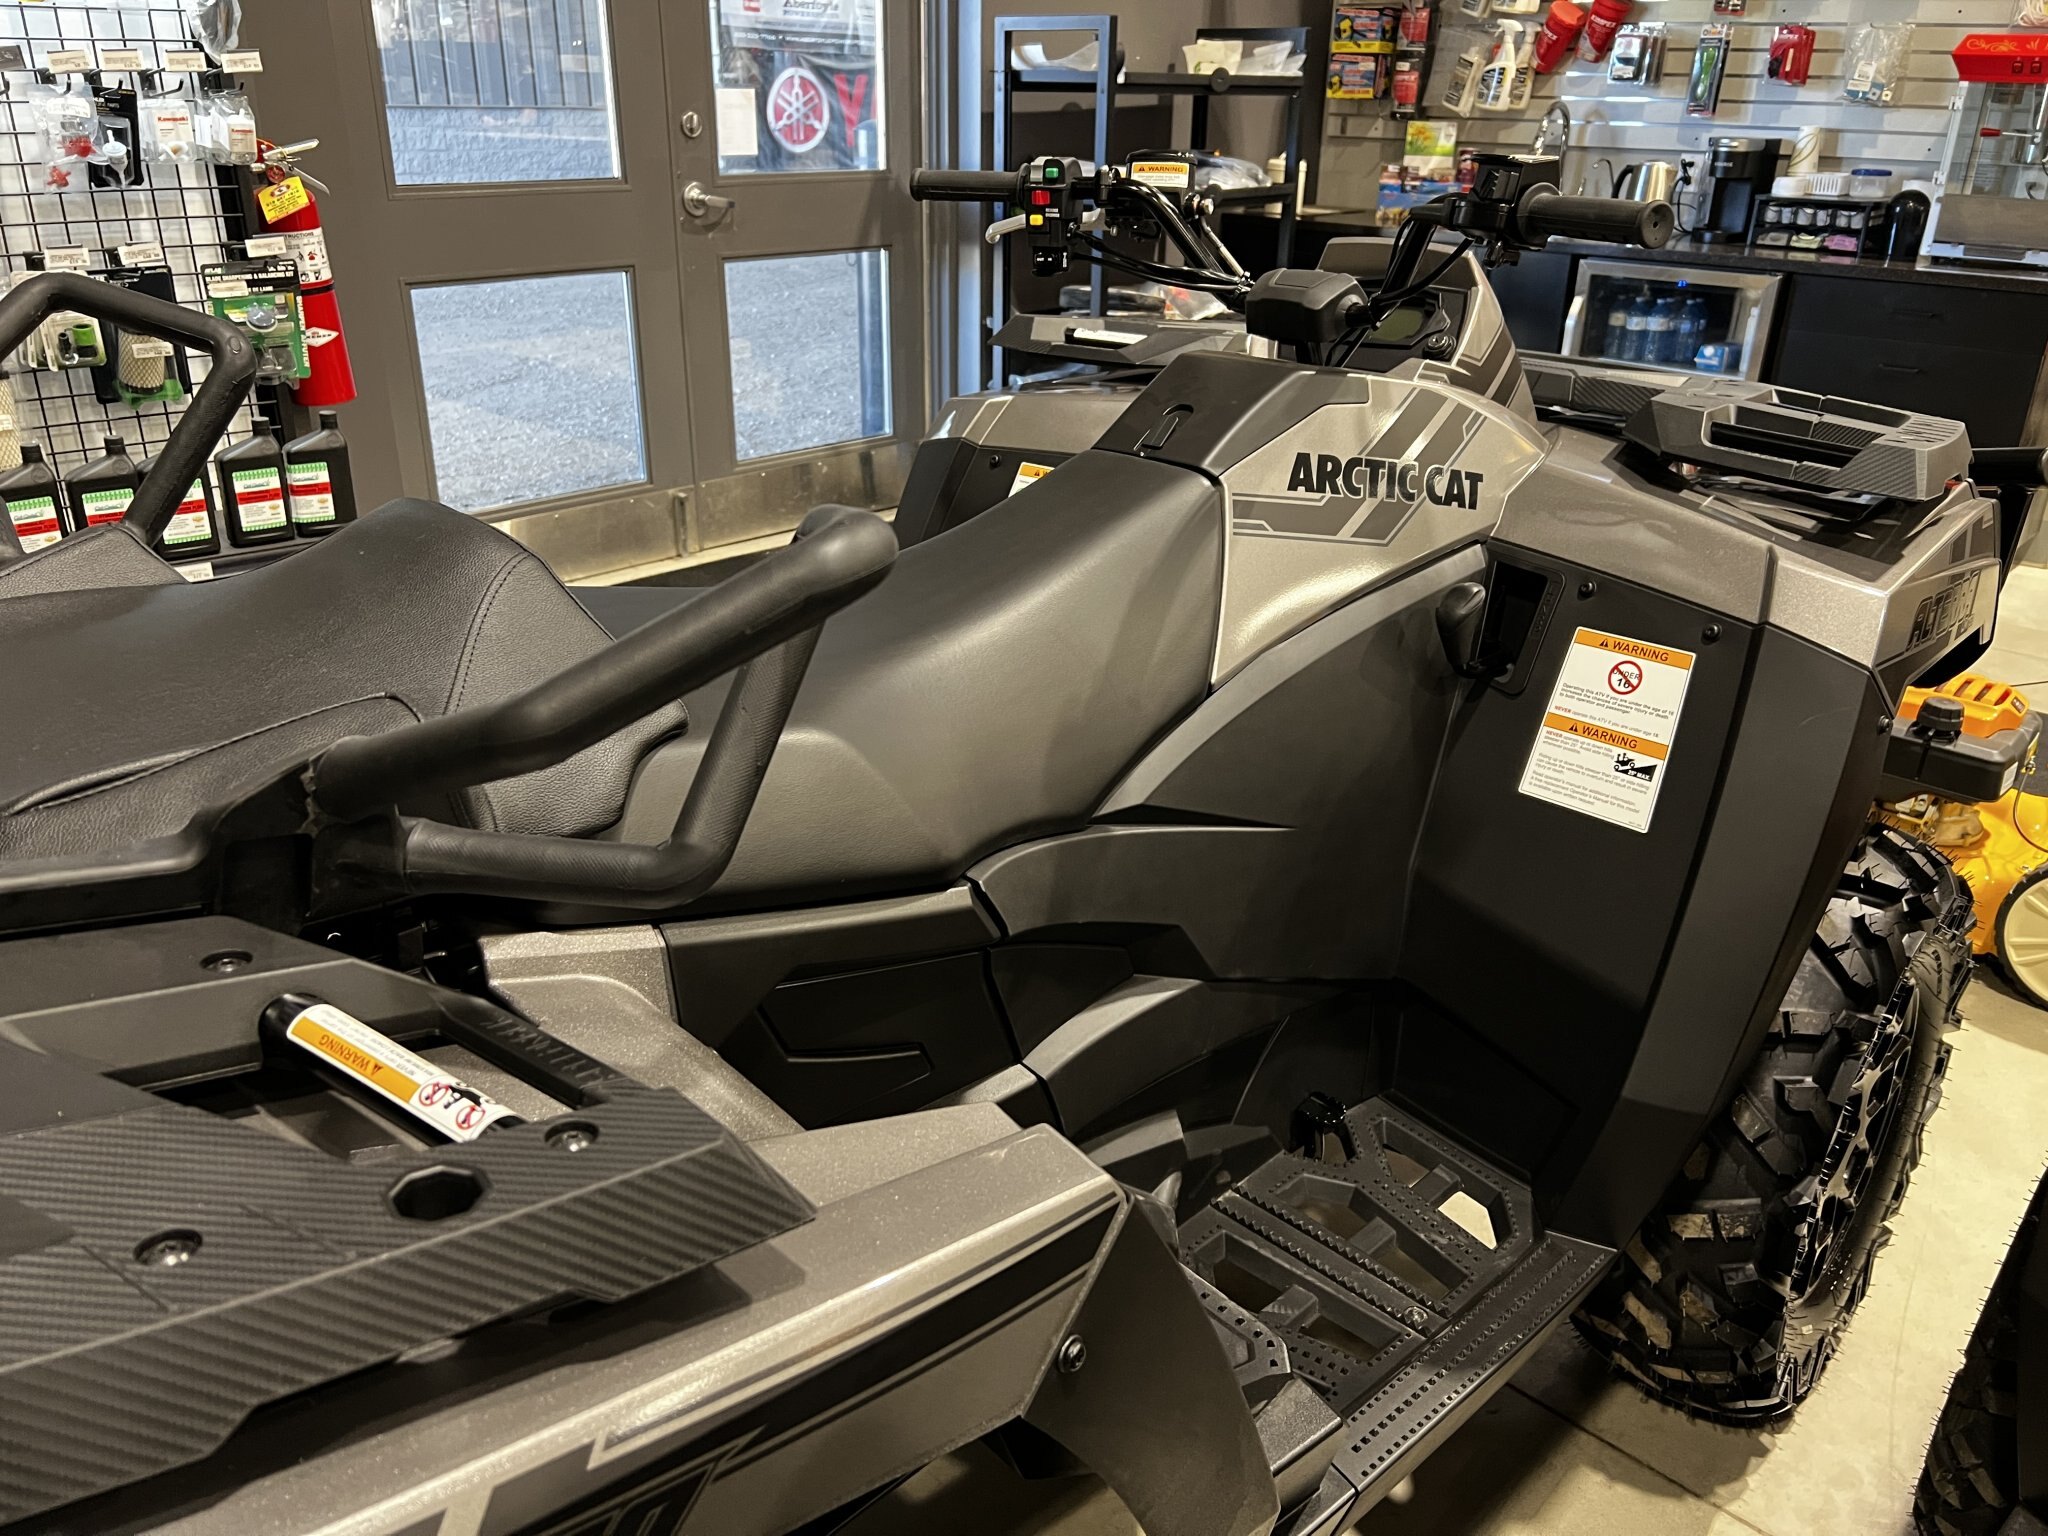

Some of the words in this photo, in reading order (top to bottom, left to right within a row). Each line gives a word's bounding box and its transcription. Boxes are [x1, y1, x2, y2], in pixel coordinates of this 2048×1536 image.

[1287, 452, 1418, 503] ARCTIC
[1424, 464, 1483, 510] CAT
[1612, 640, 1669, 662] WARNING
[1612, 668, 1640, 680] UNDER
[1615, 677, 1631, 689] 16
[1554, 705, 1571, 713] NEVER
[1546, 730, 1562, 738] NEVER
[1581, 725, 1638, 749] WARNING
[316, 1031, 371, 1072] WARNING
